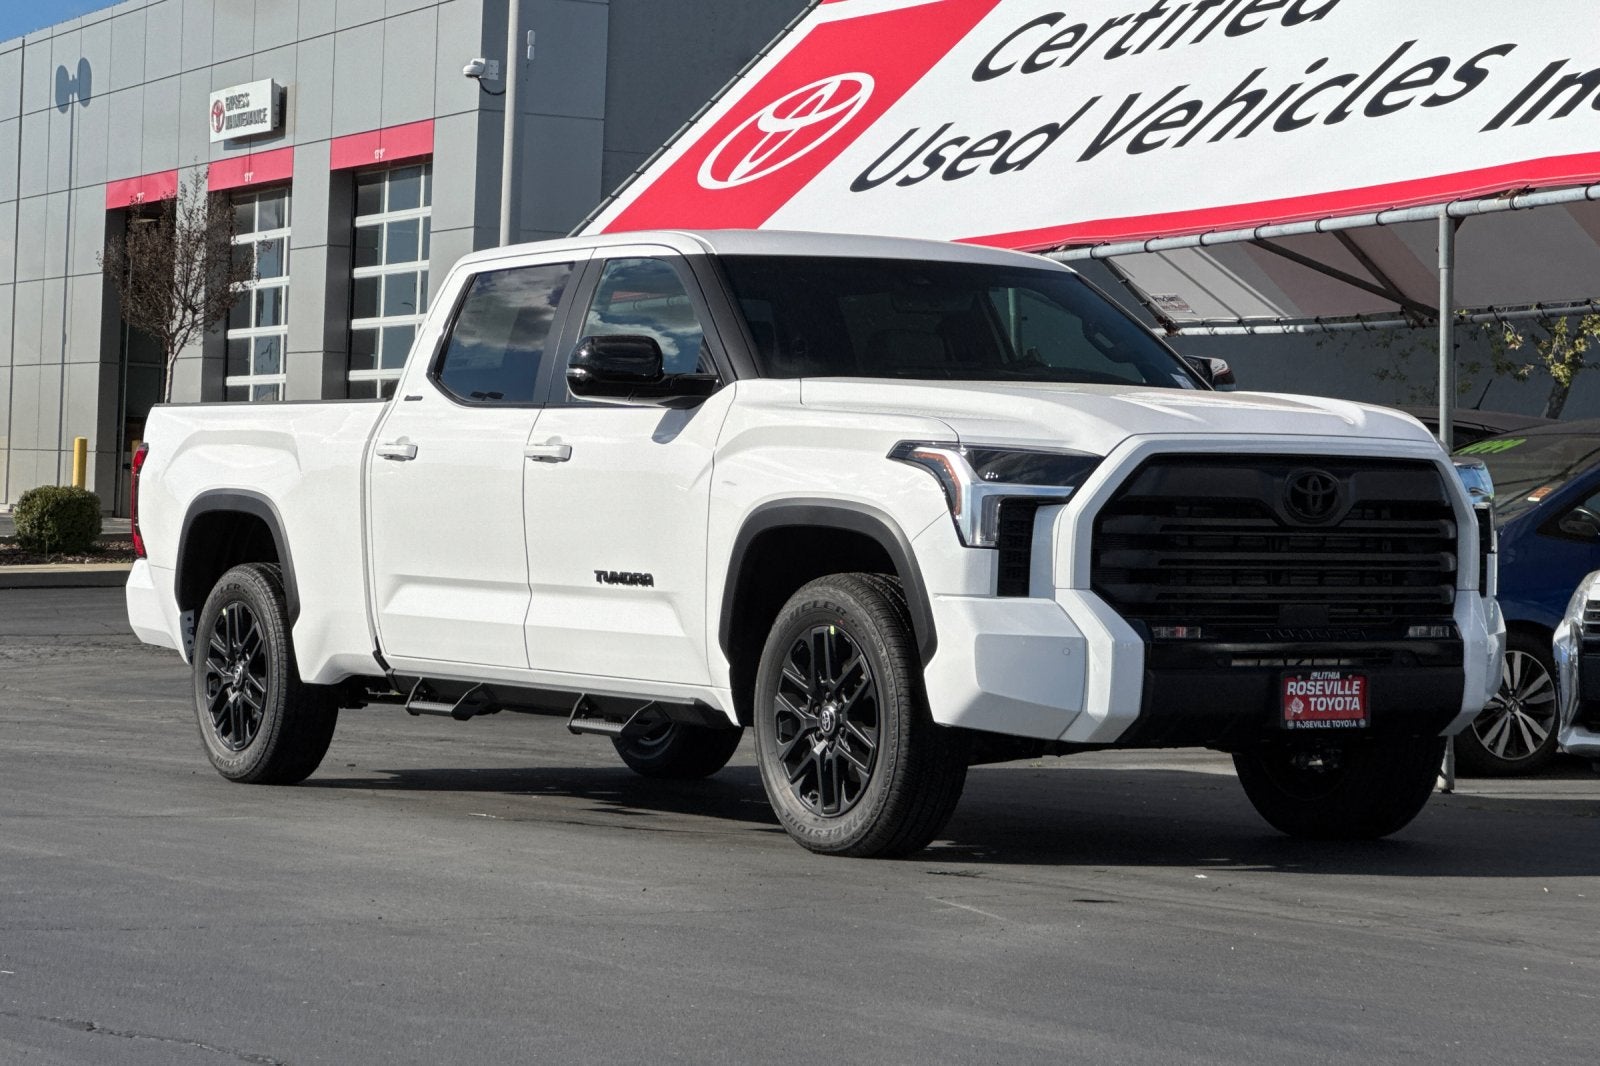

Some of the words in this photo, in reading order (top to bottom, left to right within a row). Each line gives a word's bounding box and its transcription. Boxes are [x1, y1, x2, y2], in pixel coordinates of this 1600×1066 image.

[849, 95, 1103, 192] Used
[1076, 40, 1518, 163] Vehicles
[1478, 58, 1600, 133] In
[594, 569, 654, 587] TUNDRA
[1316, 671, 1341, 680] LITHIA
[1286, 680, 1361, 696] ROSEVILLE
[1309, 696, 1361, 712] TOYOTA
[1296, 720, 1331, 729] ROSEVILLE
[1332, 719, 1357, 728] TOYOTA
